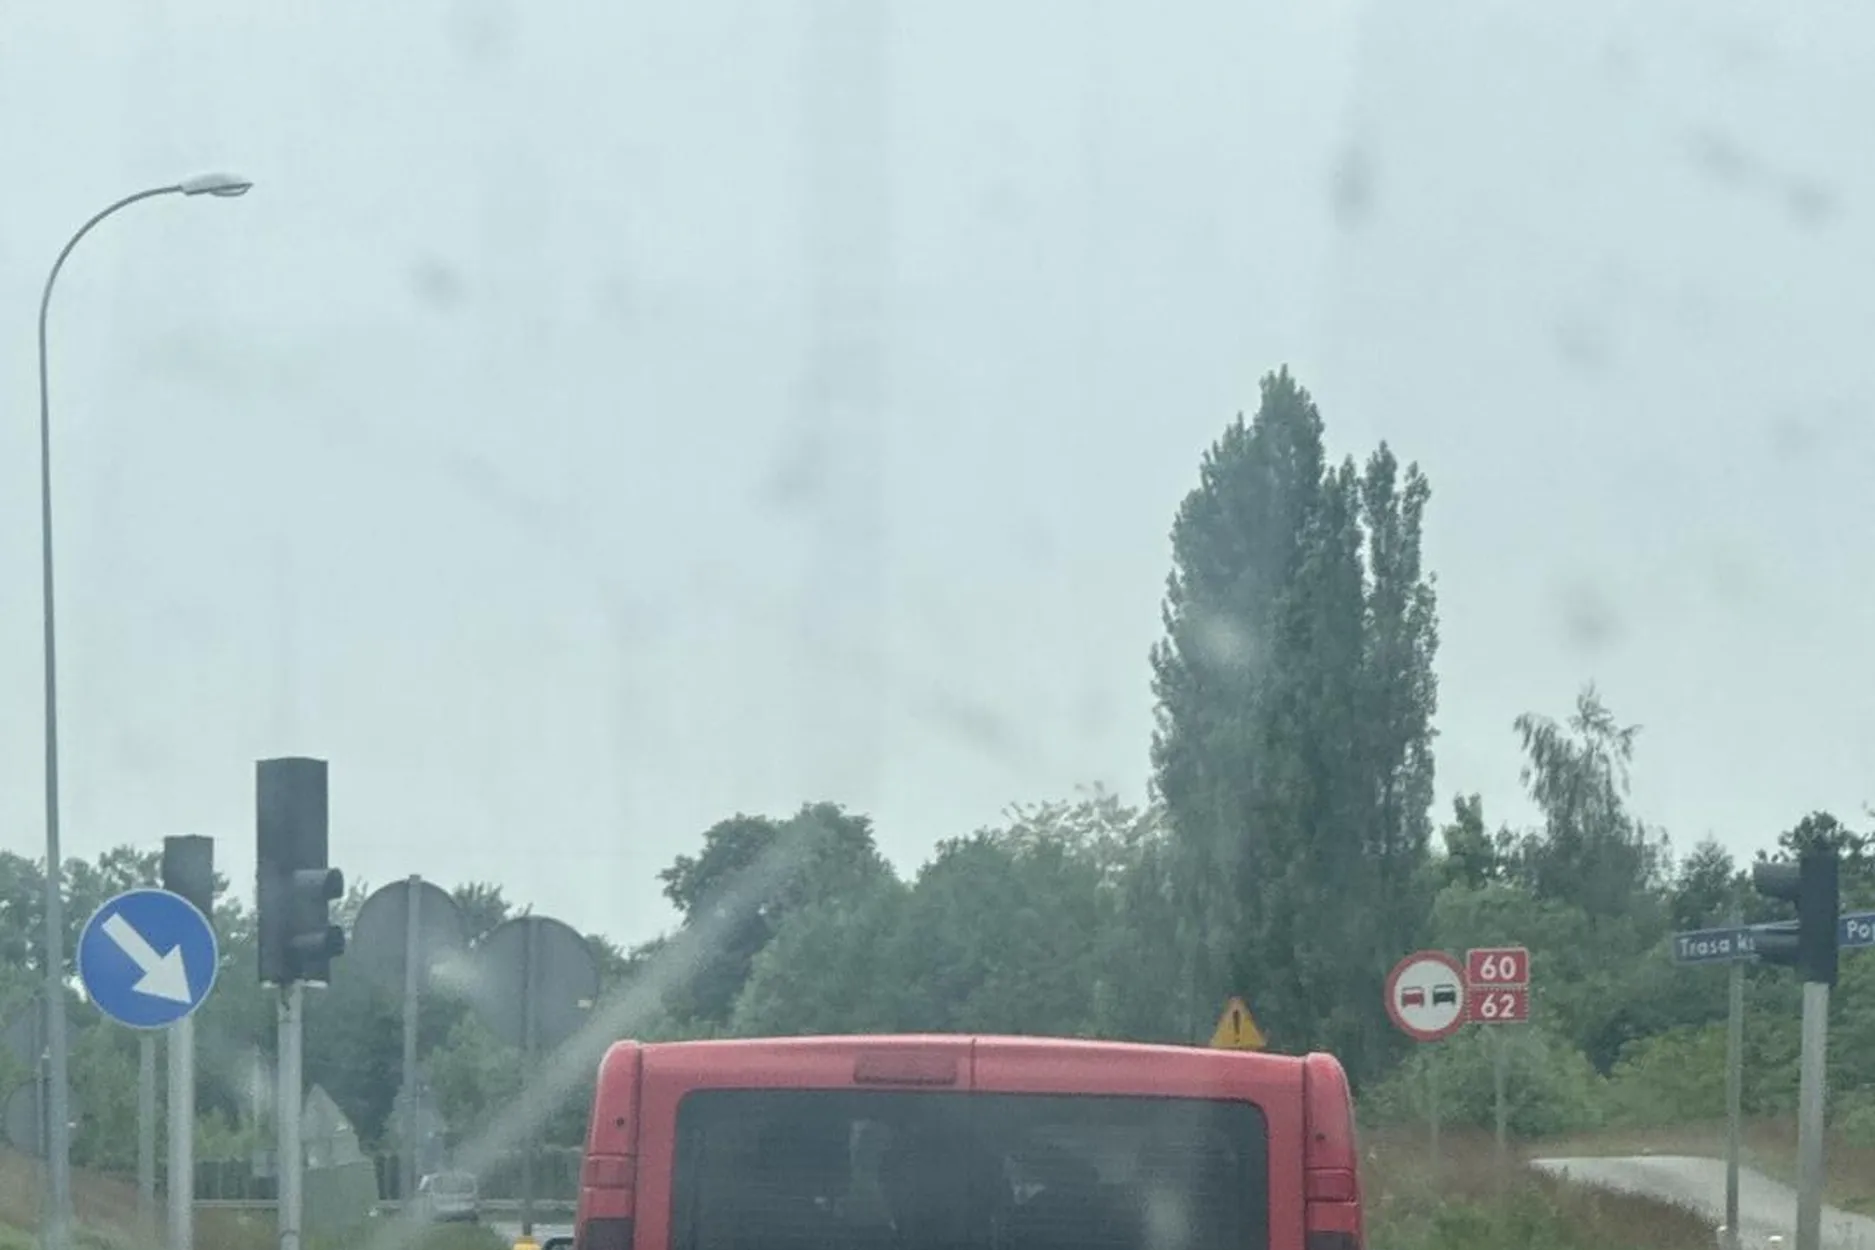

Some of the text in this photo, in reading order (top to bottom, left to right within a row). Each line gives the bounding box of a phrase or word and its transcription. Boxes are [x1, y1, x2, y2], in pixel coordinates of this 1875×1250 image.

[1679, 937, 1731, 957] Trasa
[1480, 955, 1517, 980] 60
[1480, 993, 1516, 1018] 62
